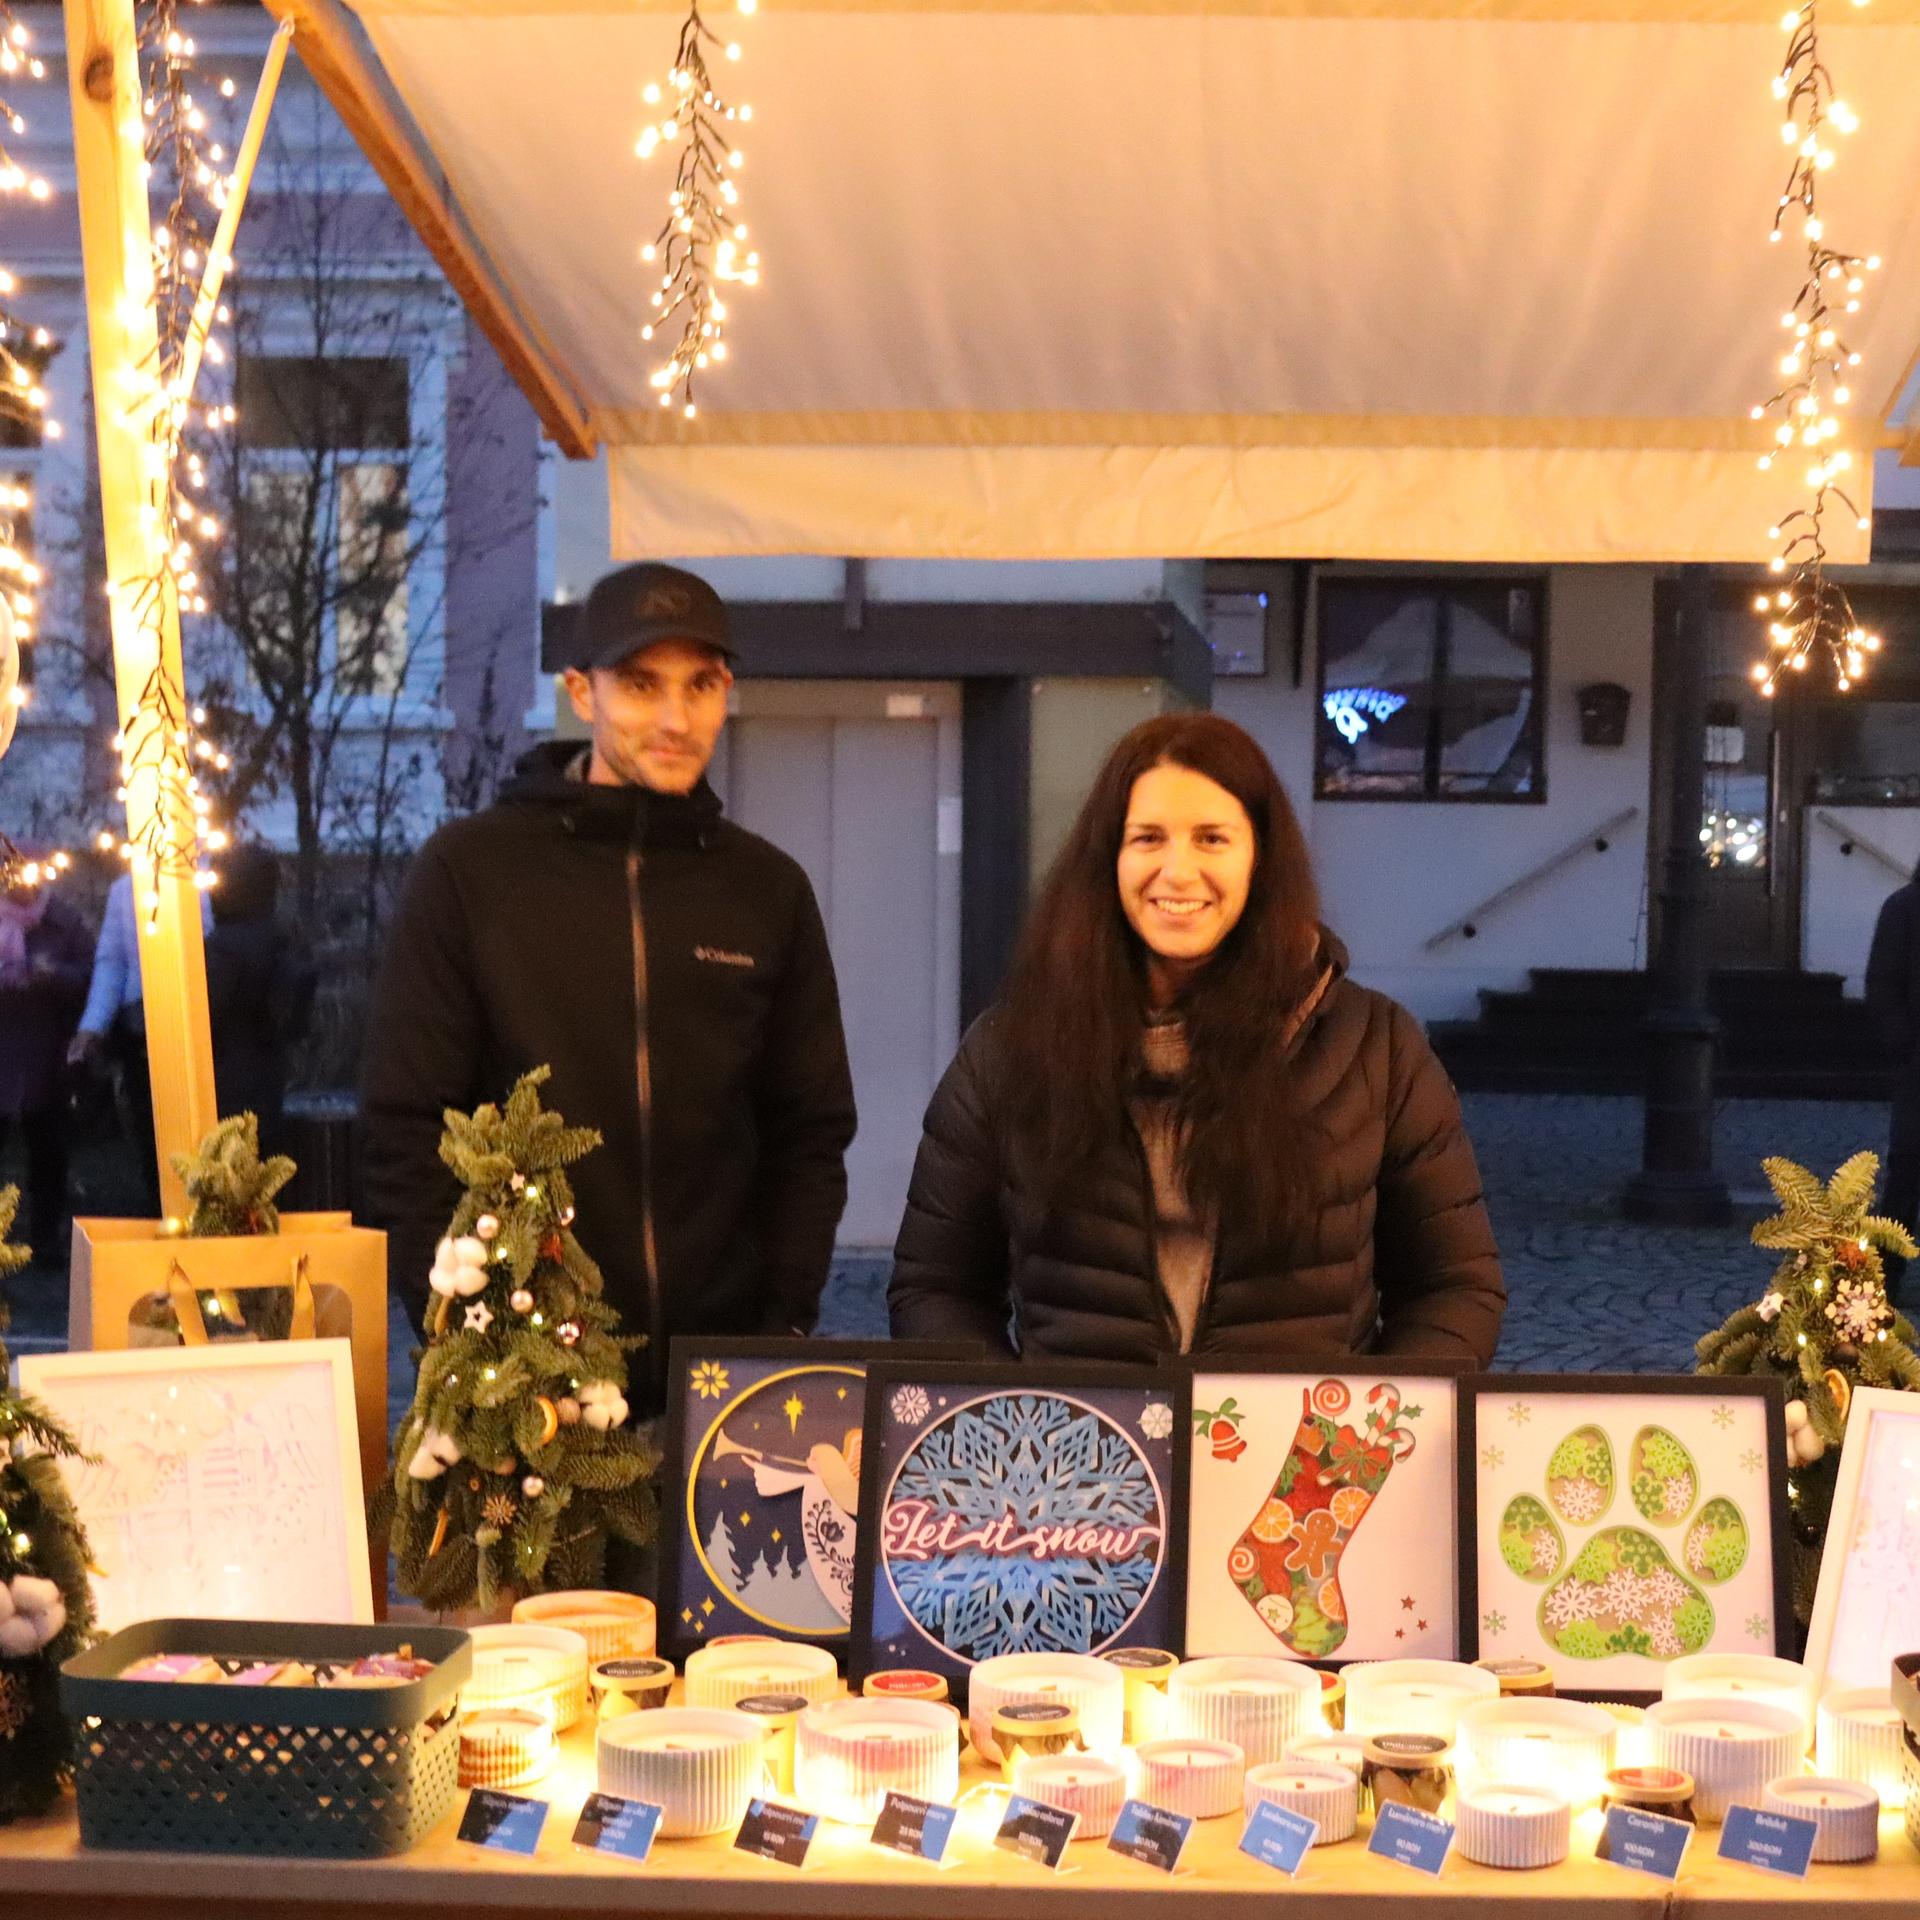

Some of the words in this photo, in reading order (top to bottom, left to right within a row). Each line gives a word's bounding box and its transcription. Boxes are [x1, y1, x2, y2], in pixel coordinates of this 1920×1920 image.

[885, 1500, 958, 1559] Let
[984, 1513, 1015, 1551] it
[1029, 1524, 1162, 1557] snow
